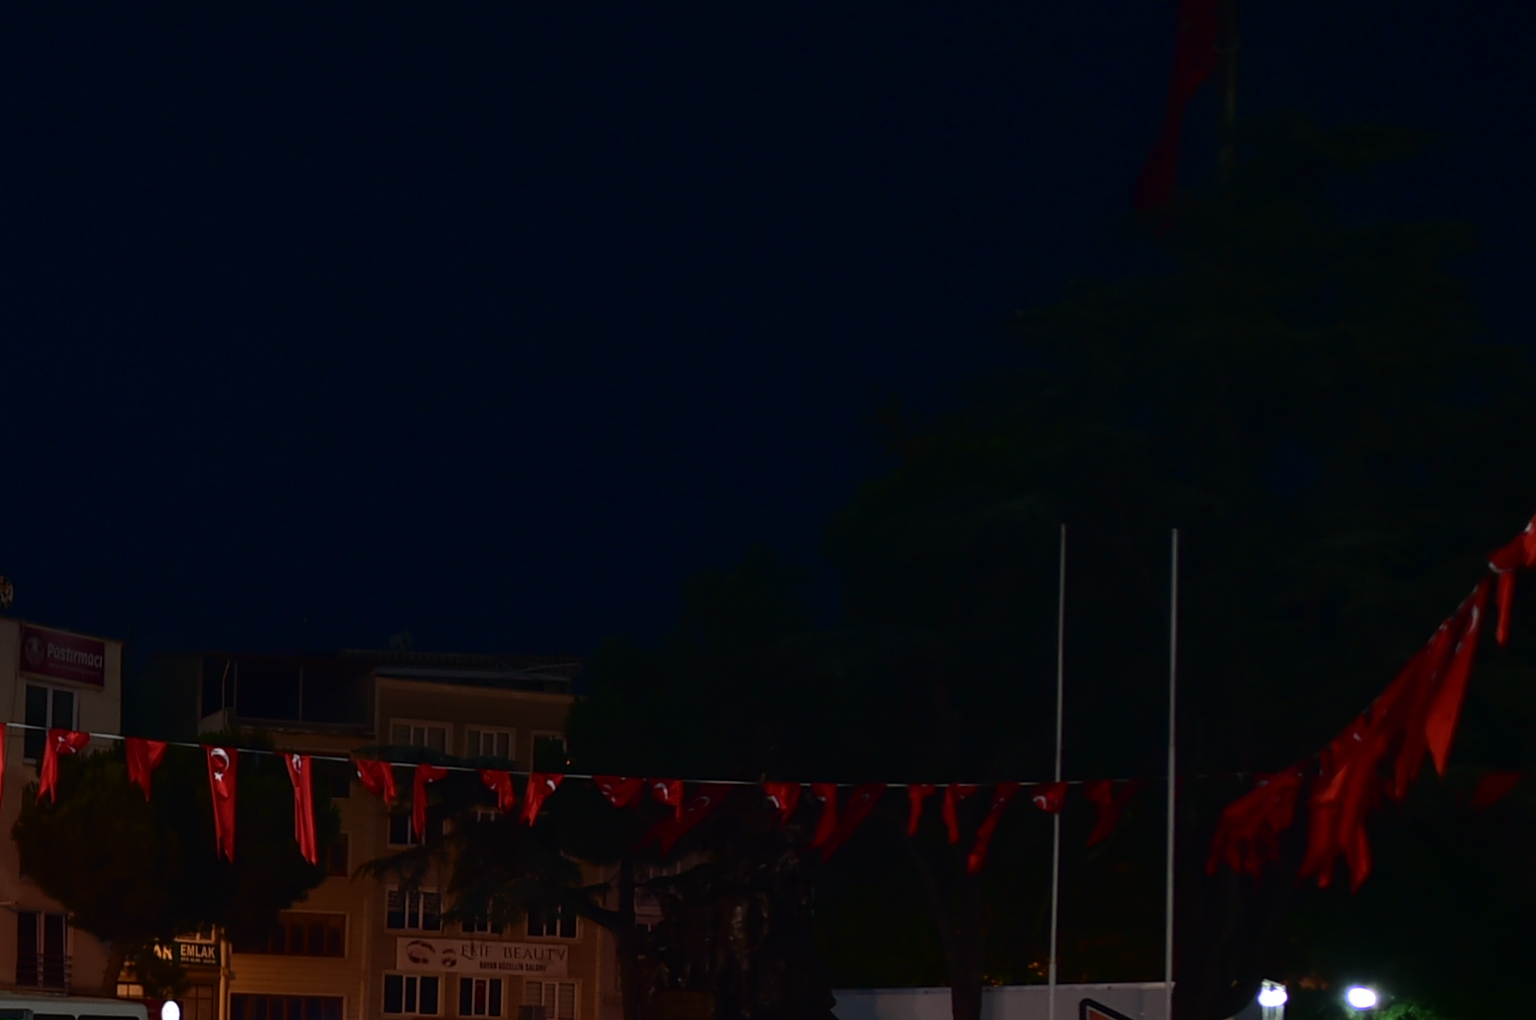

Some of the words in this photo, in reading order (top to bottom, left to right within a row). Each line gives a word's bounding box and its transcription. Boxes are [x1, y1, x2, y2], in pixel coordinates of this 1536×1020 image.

[47, 643, 104, 669] Pastırmacı
[180, 943, 216, 959] EMLAK
[503, 947, 567, 961] BEAUTY
